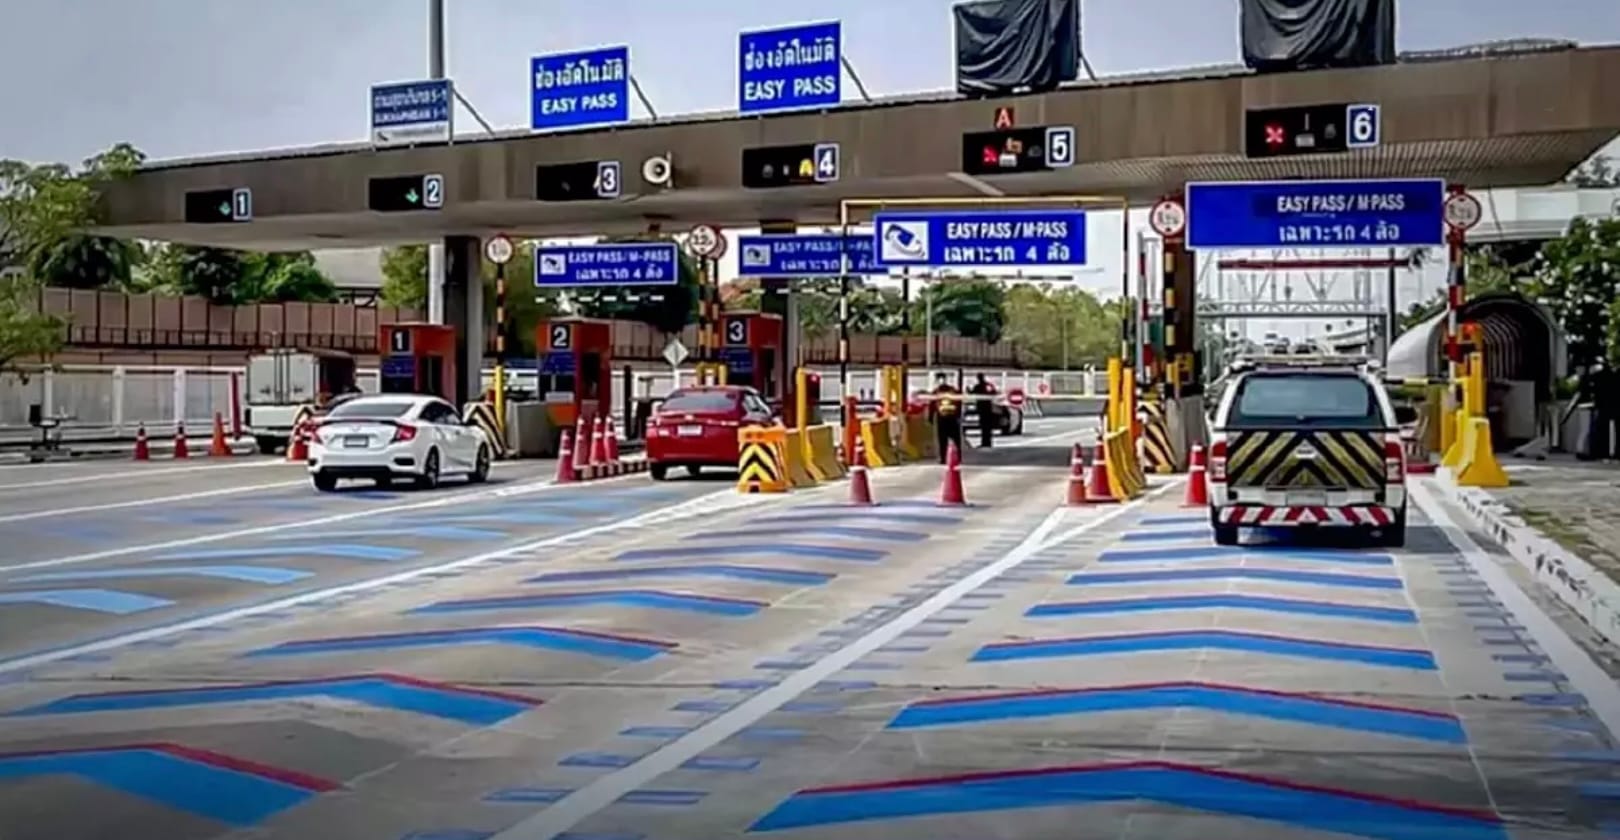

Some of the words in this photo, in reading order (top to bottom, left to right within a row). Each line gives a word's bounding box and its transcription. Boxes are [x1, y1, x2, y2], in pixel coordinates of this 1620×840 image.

[745, 36, 835, 71] ช่องอัตโนมัติ
[536, 57, 624, 89] ช่องอัตโนมัติ
[744, 79, 785, 101] EASY
[793, 75, 836, 97] PASS
[541, 97, 577, 115] EASY
[582, 93, 617, 110] PASS
[996, 108, 1012, 128] A
[1354, 112, 1372, 141] 6
[1052, 133, 1067, 161] 5
[819, 150, 834, 175] 4
[603, 168, 616, 190] 3
[428, 180, 439, 202] 2
[238, 195, 246, 214] 1
[1278, 196, 1309, 213] EASY
[1311, 194, 1346, 212] PASS
[1358, 194, 1405, 211] M-PASS
[947, 222, 979, 239] EASY
[981, 222, 1012, 238] PASS
[1022, 221, 1067, 238] M-PASS
[1360, 224, 1371, 240] 4
[568, 251, 595, 264] EASY
[773, 242, 801, 253] EASY
[1026, 245, 1037, 261] 4
[633, 268, 641, 279] 4
[395, 332, 404, 350] 1
[553, 326, 567, 346] 2
[729, 321, 744, 341] 3
